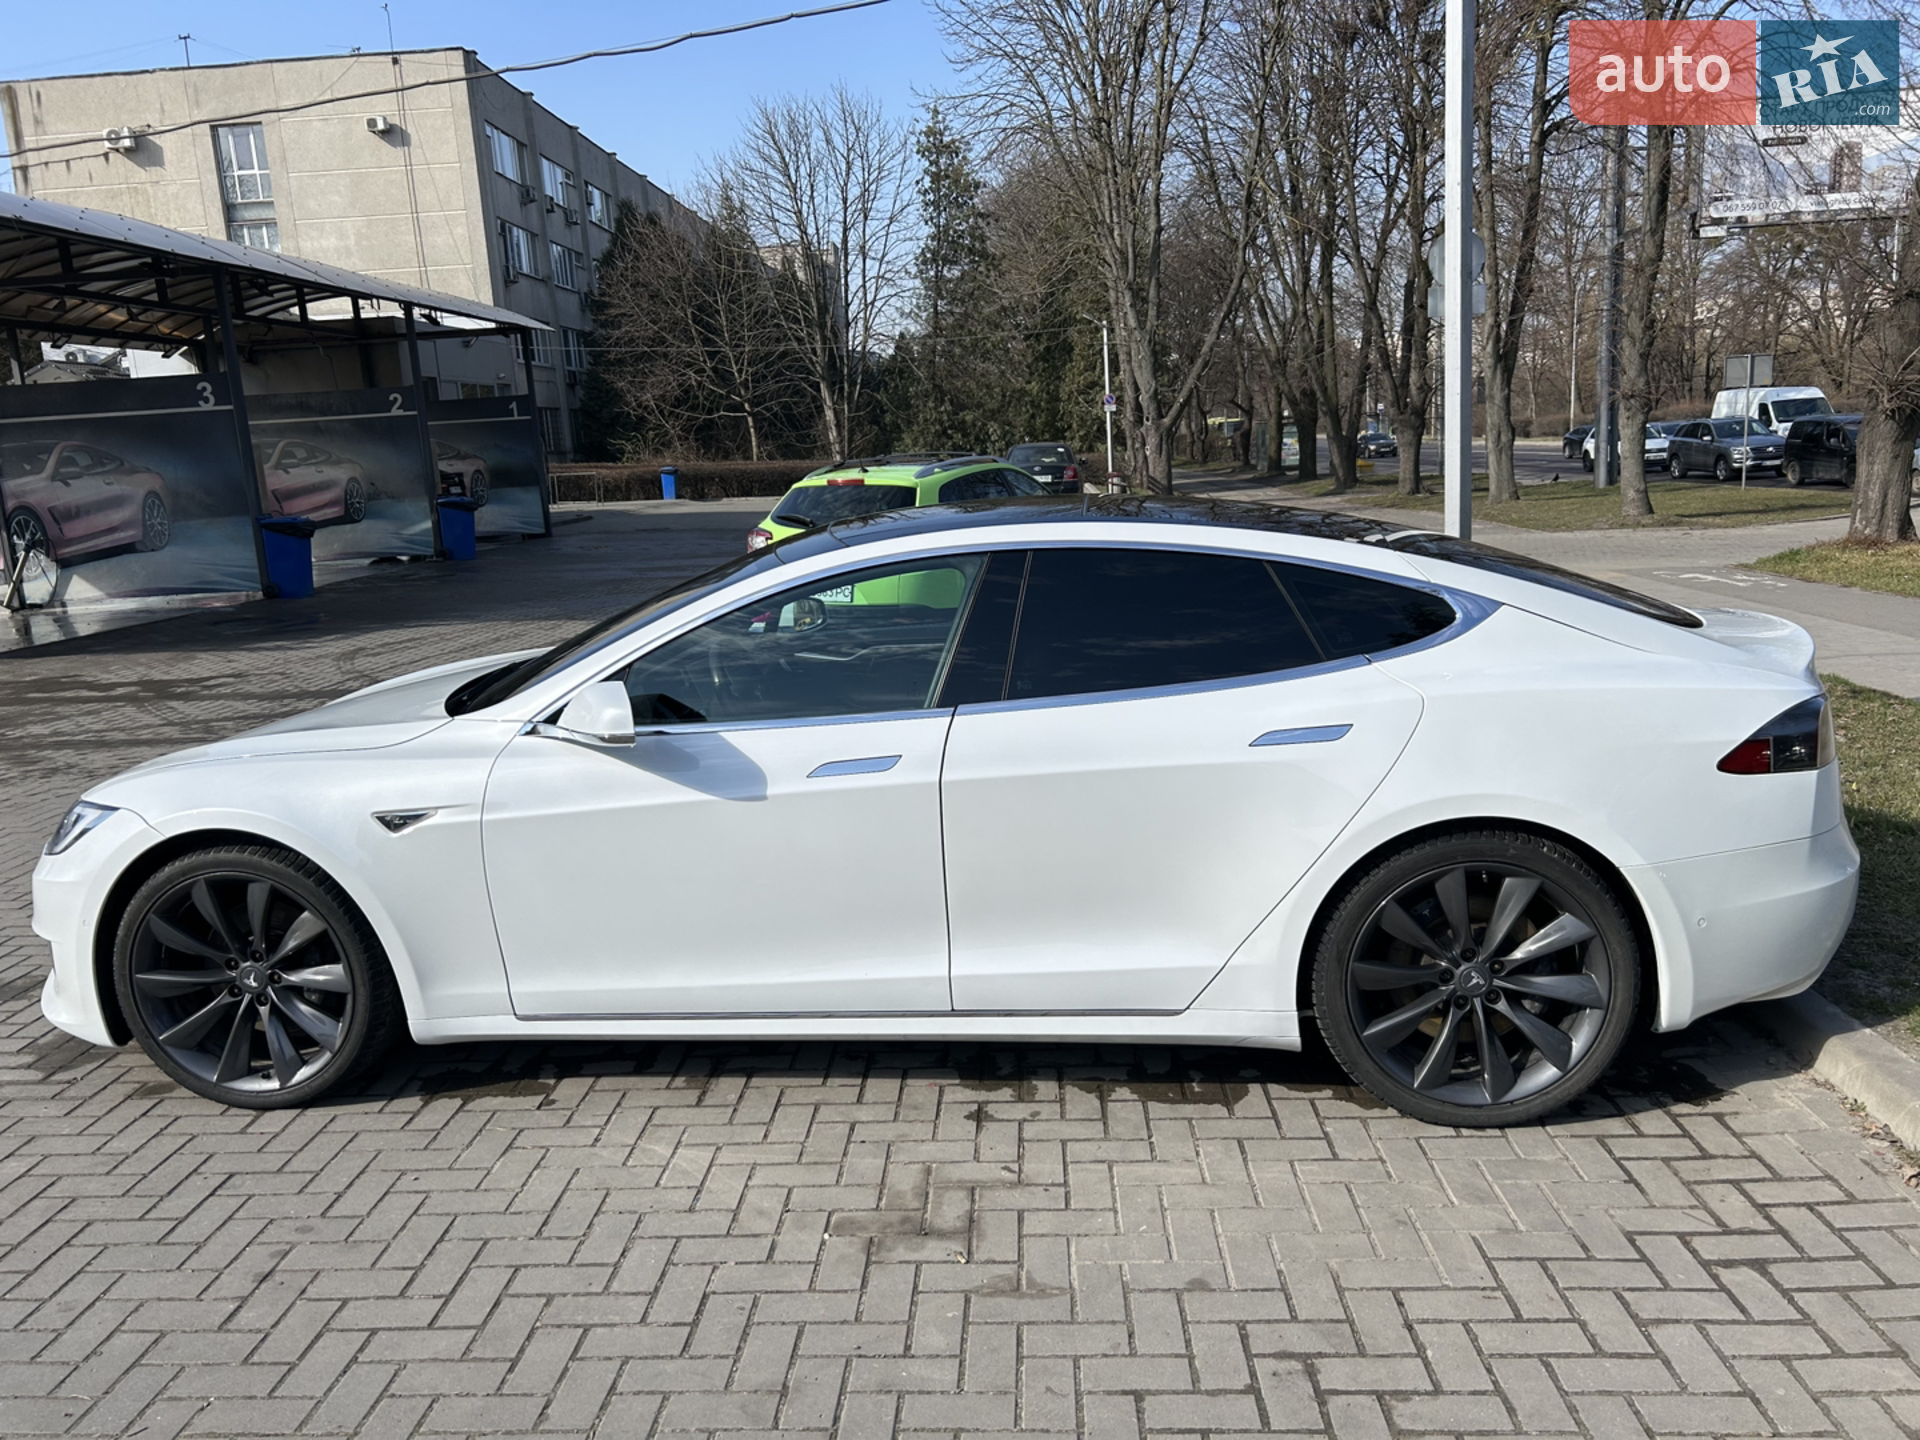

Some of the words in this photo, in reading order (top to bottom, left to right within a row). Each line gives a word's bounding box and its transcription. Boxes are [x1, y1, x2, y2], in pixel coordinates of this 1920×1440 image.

[197, 381, 215, 408] 3
[389, 393, 403, 414] 2
[508, 400, 519, 418] 1
